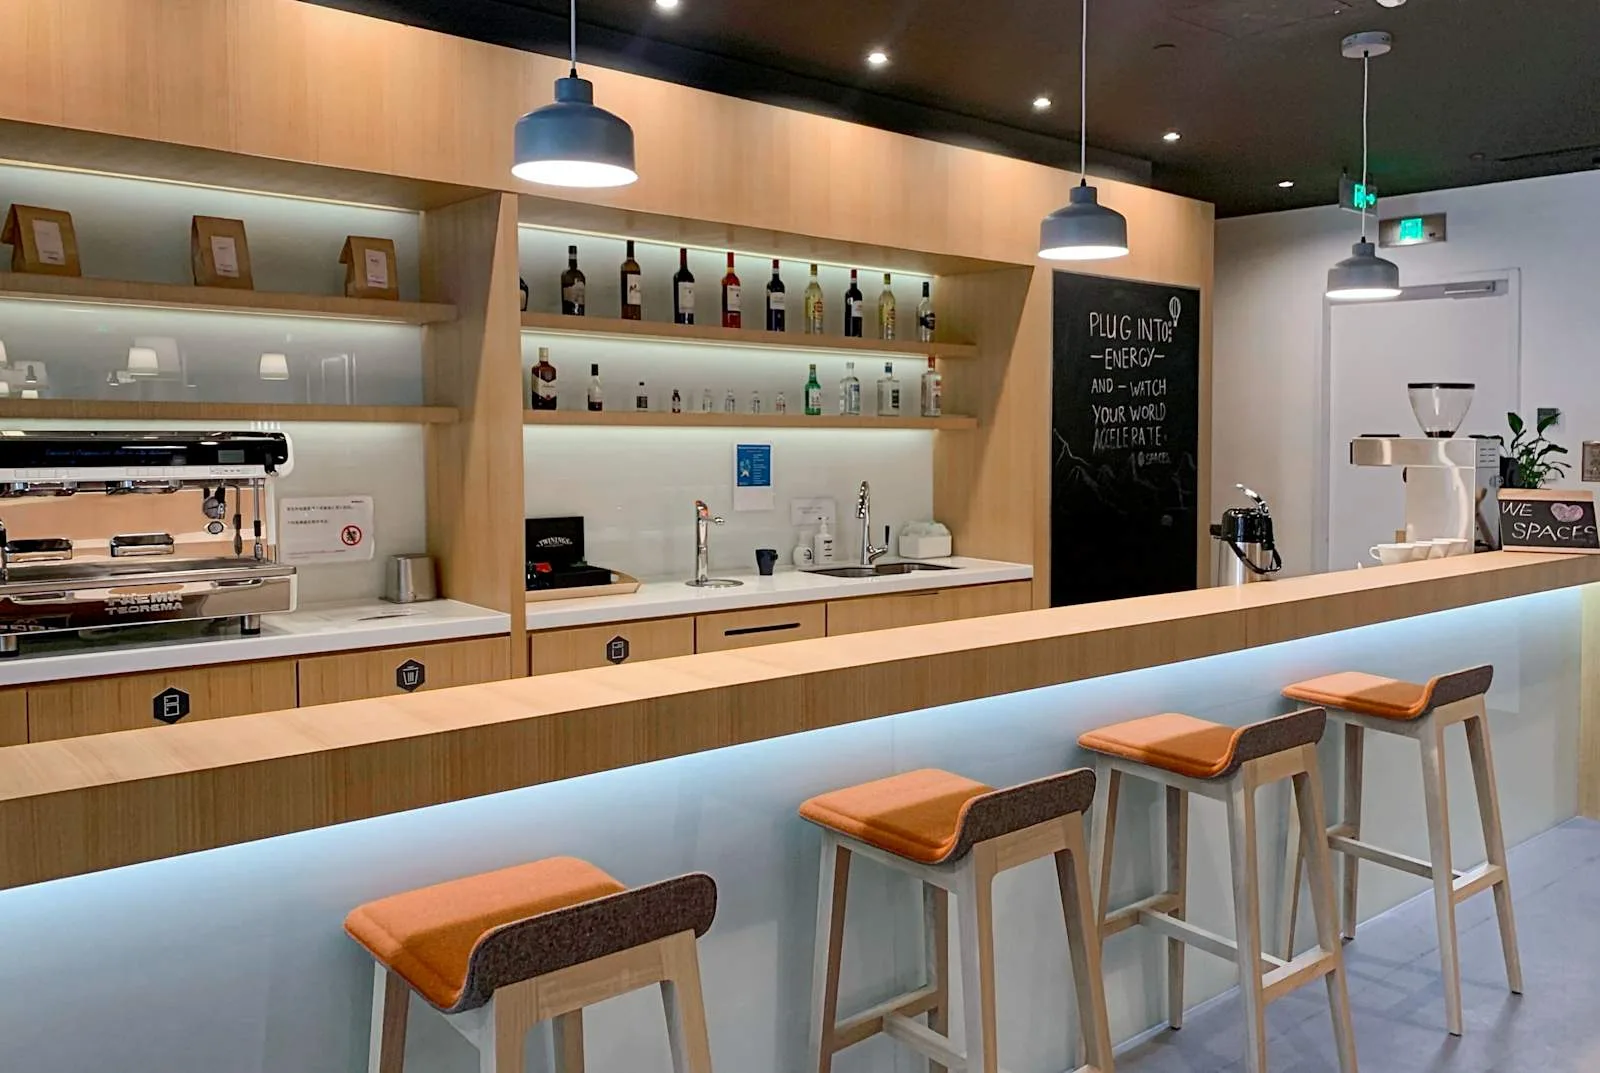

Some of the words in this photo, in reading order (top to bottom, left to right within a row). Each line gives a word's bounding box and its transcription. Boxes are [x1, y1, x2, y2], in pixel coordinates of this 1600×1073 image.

[1089, 312, 1132, 340] PLUG
[1091, 378, 1114, 394] AND
[1130, 378, 1167, 397] WATCH
[1091, 404, 1127, 424] YOUR
[1129, 402, 1167, 422] WORLD
[1502, 501, 1533, 516] WE
[1511, 522, 1597, 542] SPACES
[104, 602, 183, 615] TEOREMA
